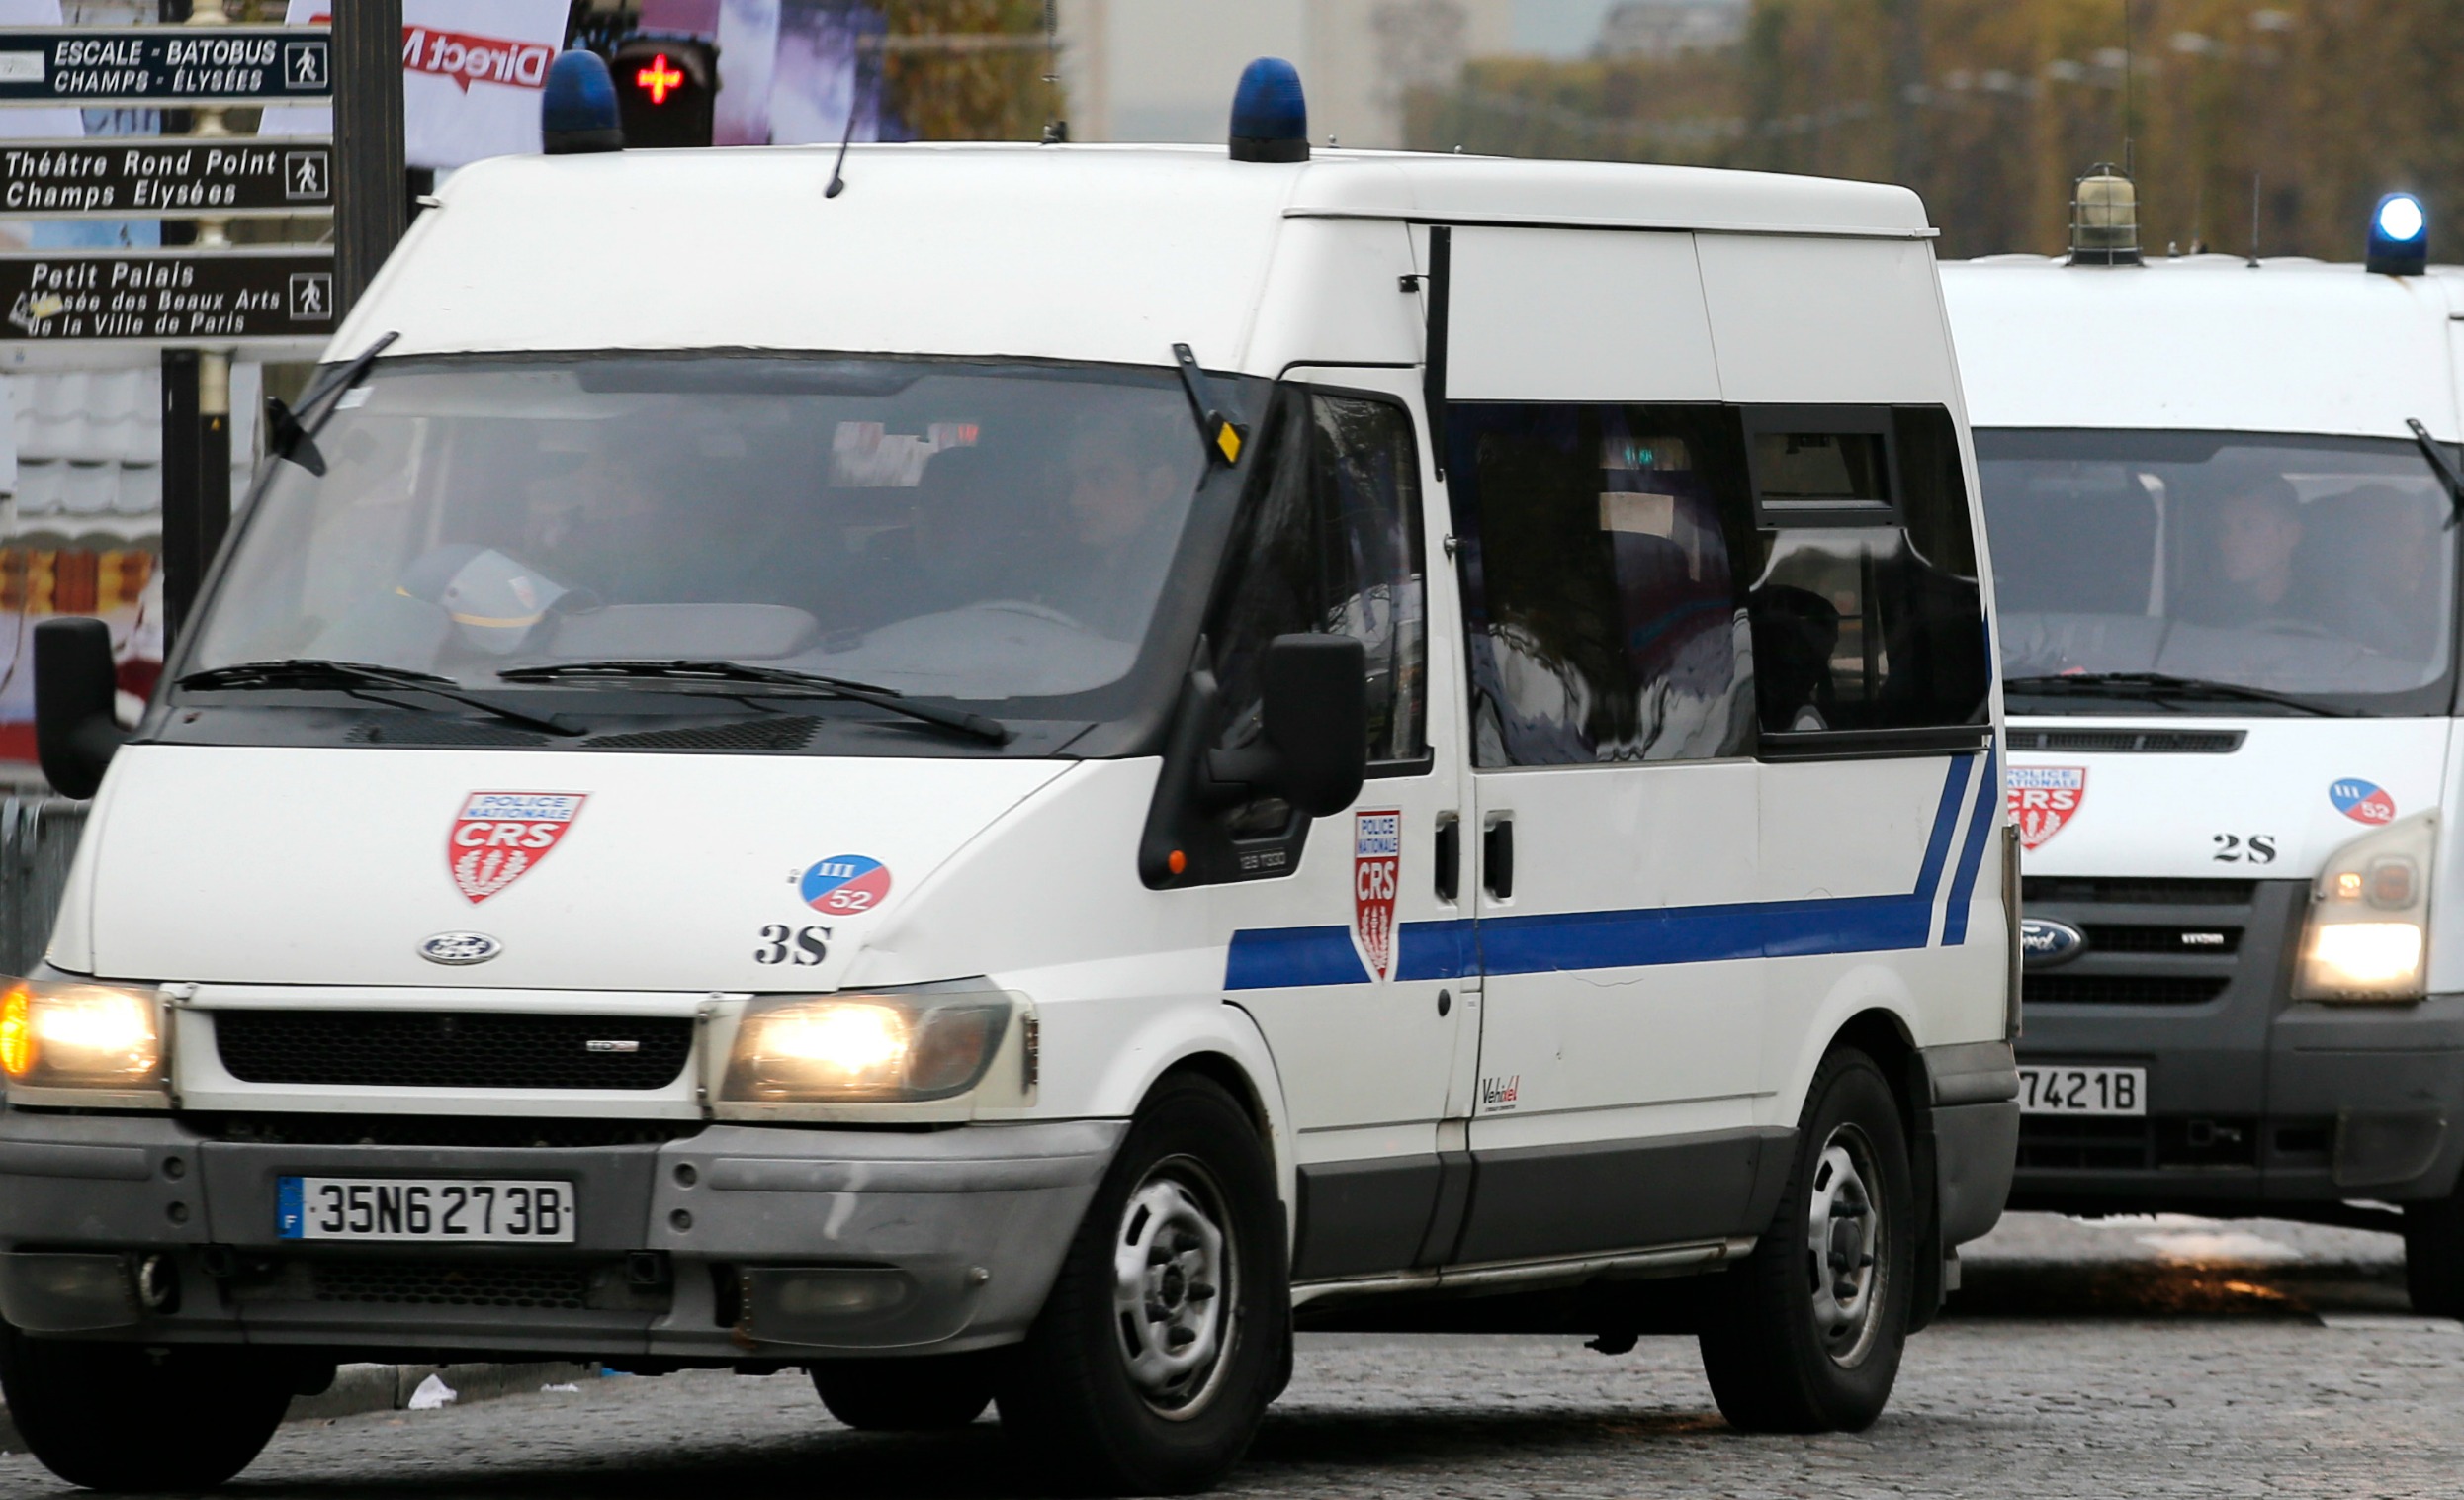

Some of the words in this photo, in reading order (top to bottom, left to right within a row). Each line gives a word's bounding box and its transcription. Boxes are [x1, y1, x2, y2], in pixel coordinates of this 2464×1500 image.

[54, 40, 144, 67] ESCALE
[165, 39, 278, 66] BATOBUS
[54, 69, 149, 93] CHAMPS
[171, 65, 264, 92] ÉLYSÉES
[5, 150, 108, 178] Théâtre
[123, 149, 193, 177] Rond
[205, 148, 277, 176] Point
[6, 180, 115, 212] Champs
[133, 178, 237, 210] Elysées
[31, 262, 99, 290] Petit
[111, 260, 195, 289] Palais
[111, 290, 148, 313] des
[158, 289, 224, 312] Beaux
[235, 288, 281, 311] Arts
[28, 314, 53, 337] de
[62, 314, 83, 336] la
[95, 312, 145, 336] Ville
[154, 312, 181, 335] de
[190, 311, 246, 334] Paris
[2008, 779, 2079, 788] ATIONALE
[465, 807, 572, 819] NATIONALE
[481, 796, 571, 807] POLICE
[2360, 800, 2393, 822] 52
[453, 822, 562, 849] CRS
[1362, 818, 1395, 835] POLICE
[1358, 837, 1398, 854] NATIONALE
[2212, 834, 2277, 864] 2S
[817, 862, 857, 878] III
[1356, 860, 1396, 901] CRS
[828, 889, 873, 910] 52
[754, 924, 834, 966] 3S
[284, 1214, 298, 1229] F
